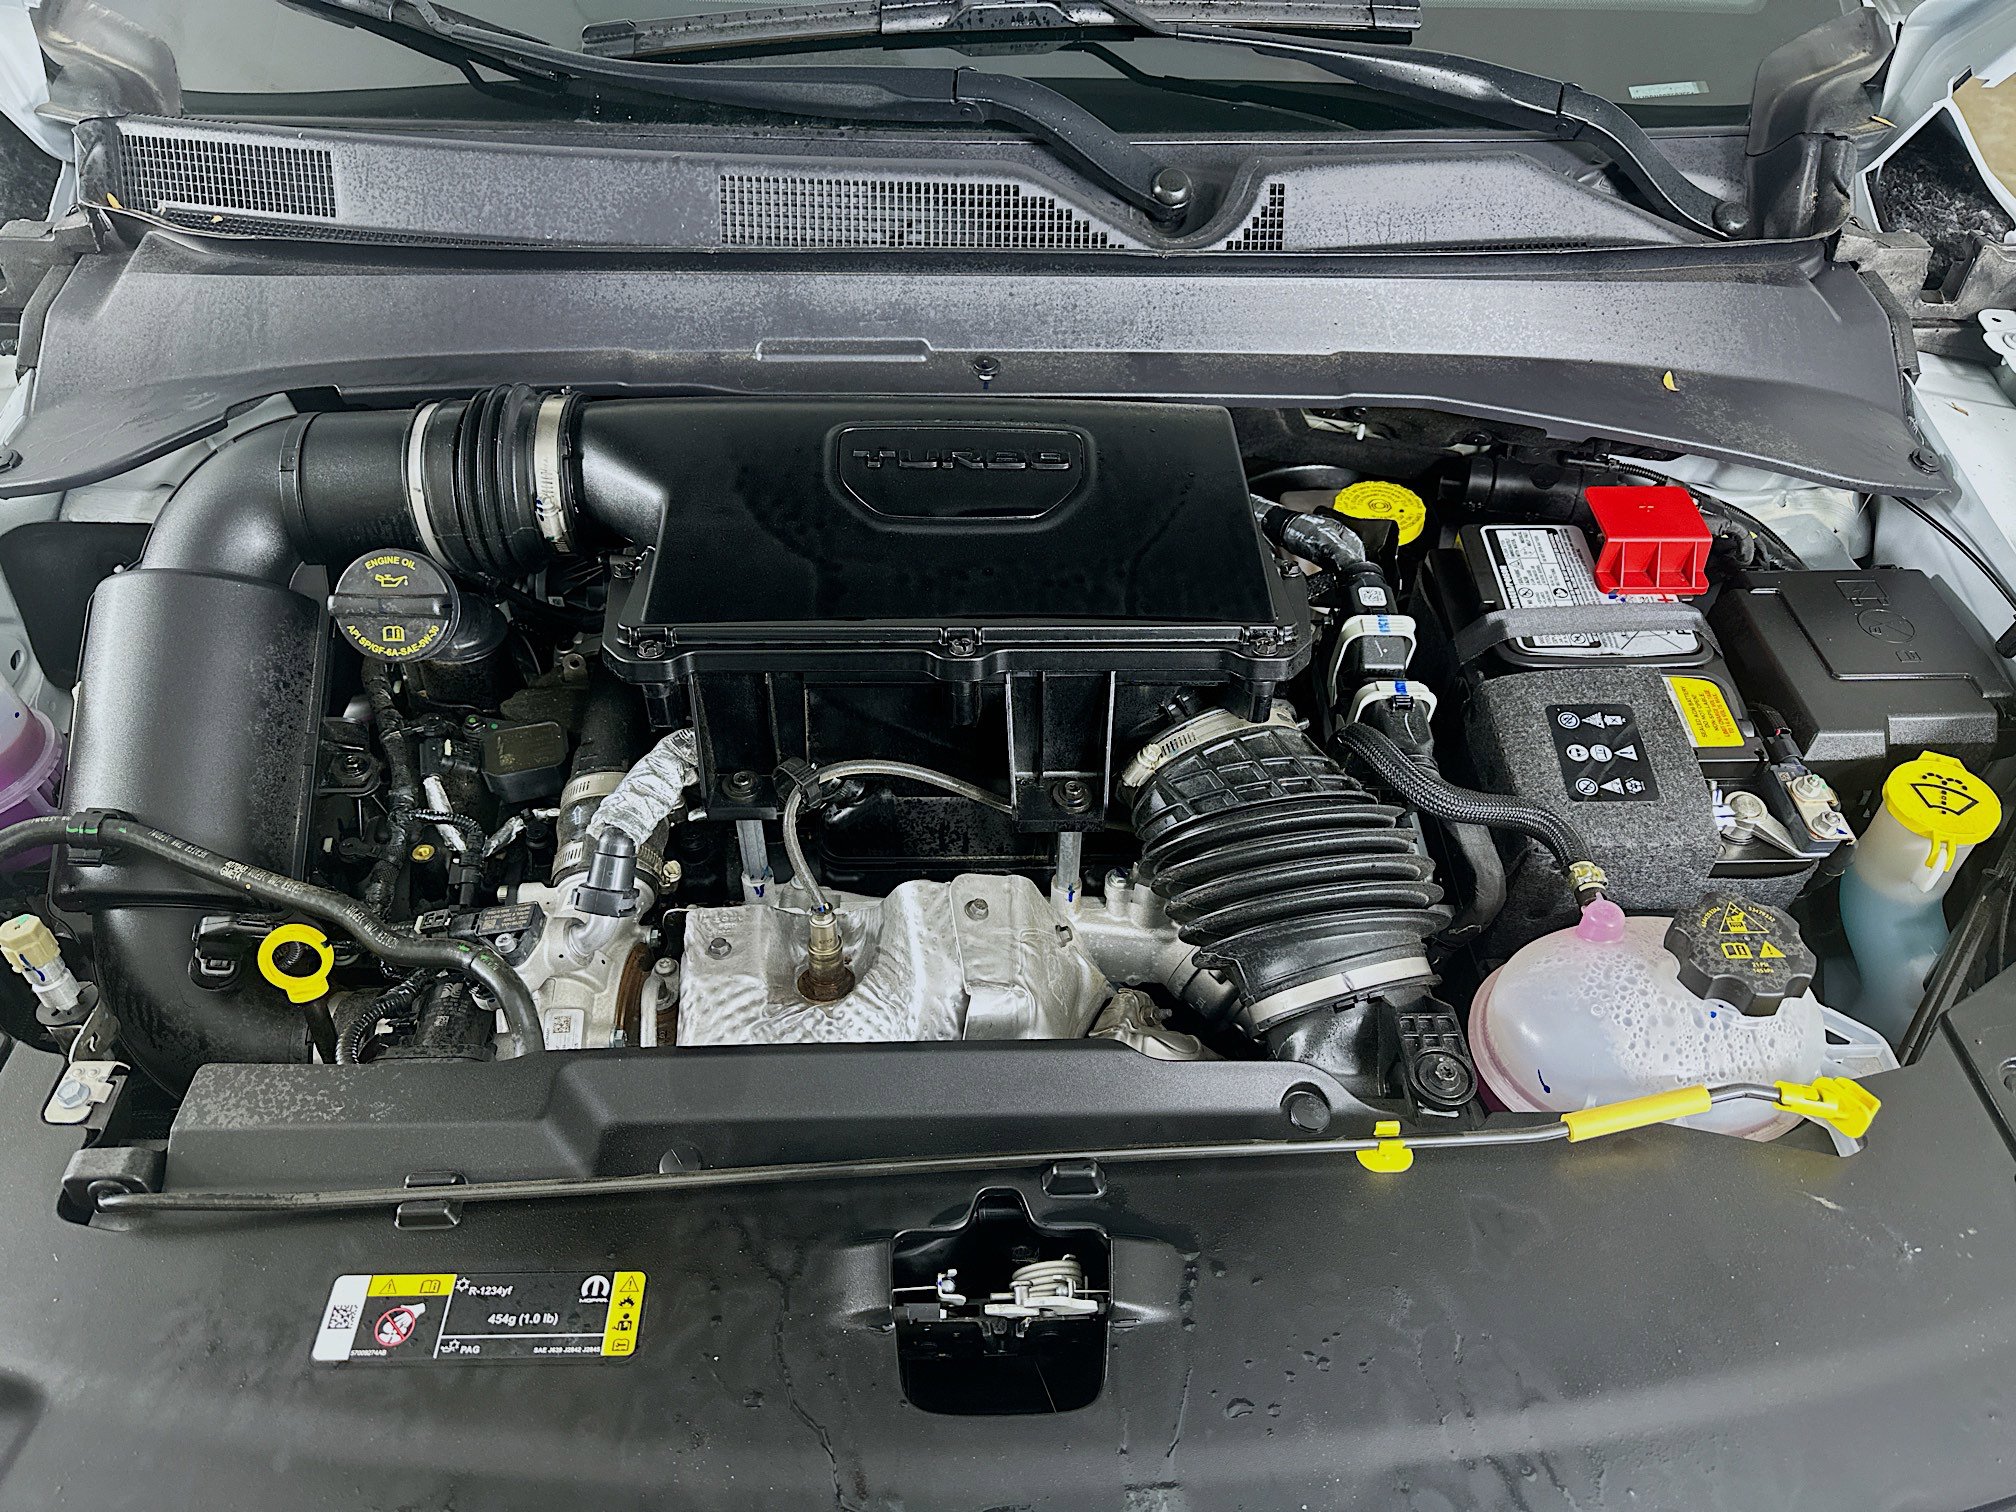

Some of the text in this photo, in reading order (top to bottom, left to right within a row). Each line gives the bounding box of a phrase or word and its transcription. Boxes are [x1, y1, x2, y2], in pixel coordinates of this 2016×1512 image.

[853, 449, 1072, 469] TURBO
[364, 556, 416, 571] ENGINE OIL
[346, 625, 362, 640] API
[468, 1285, 513, 1298] R-1234yf
[487, 1312, 559, 1327] 454g (1.0 lb)
[459, 1345, 481, 1354] PAG
[533, 1346, 548, 1354] SAE
